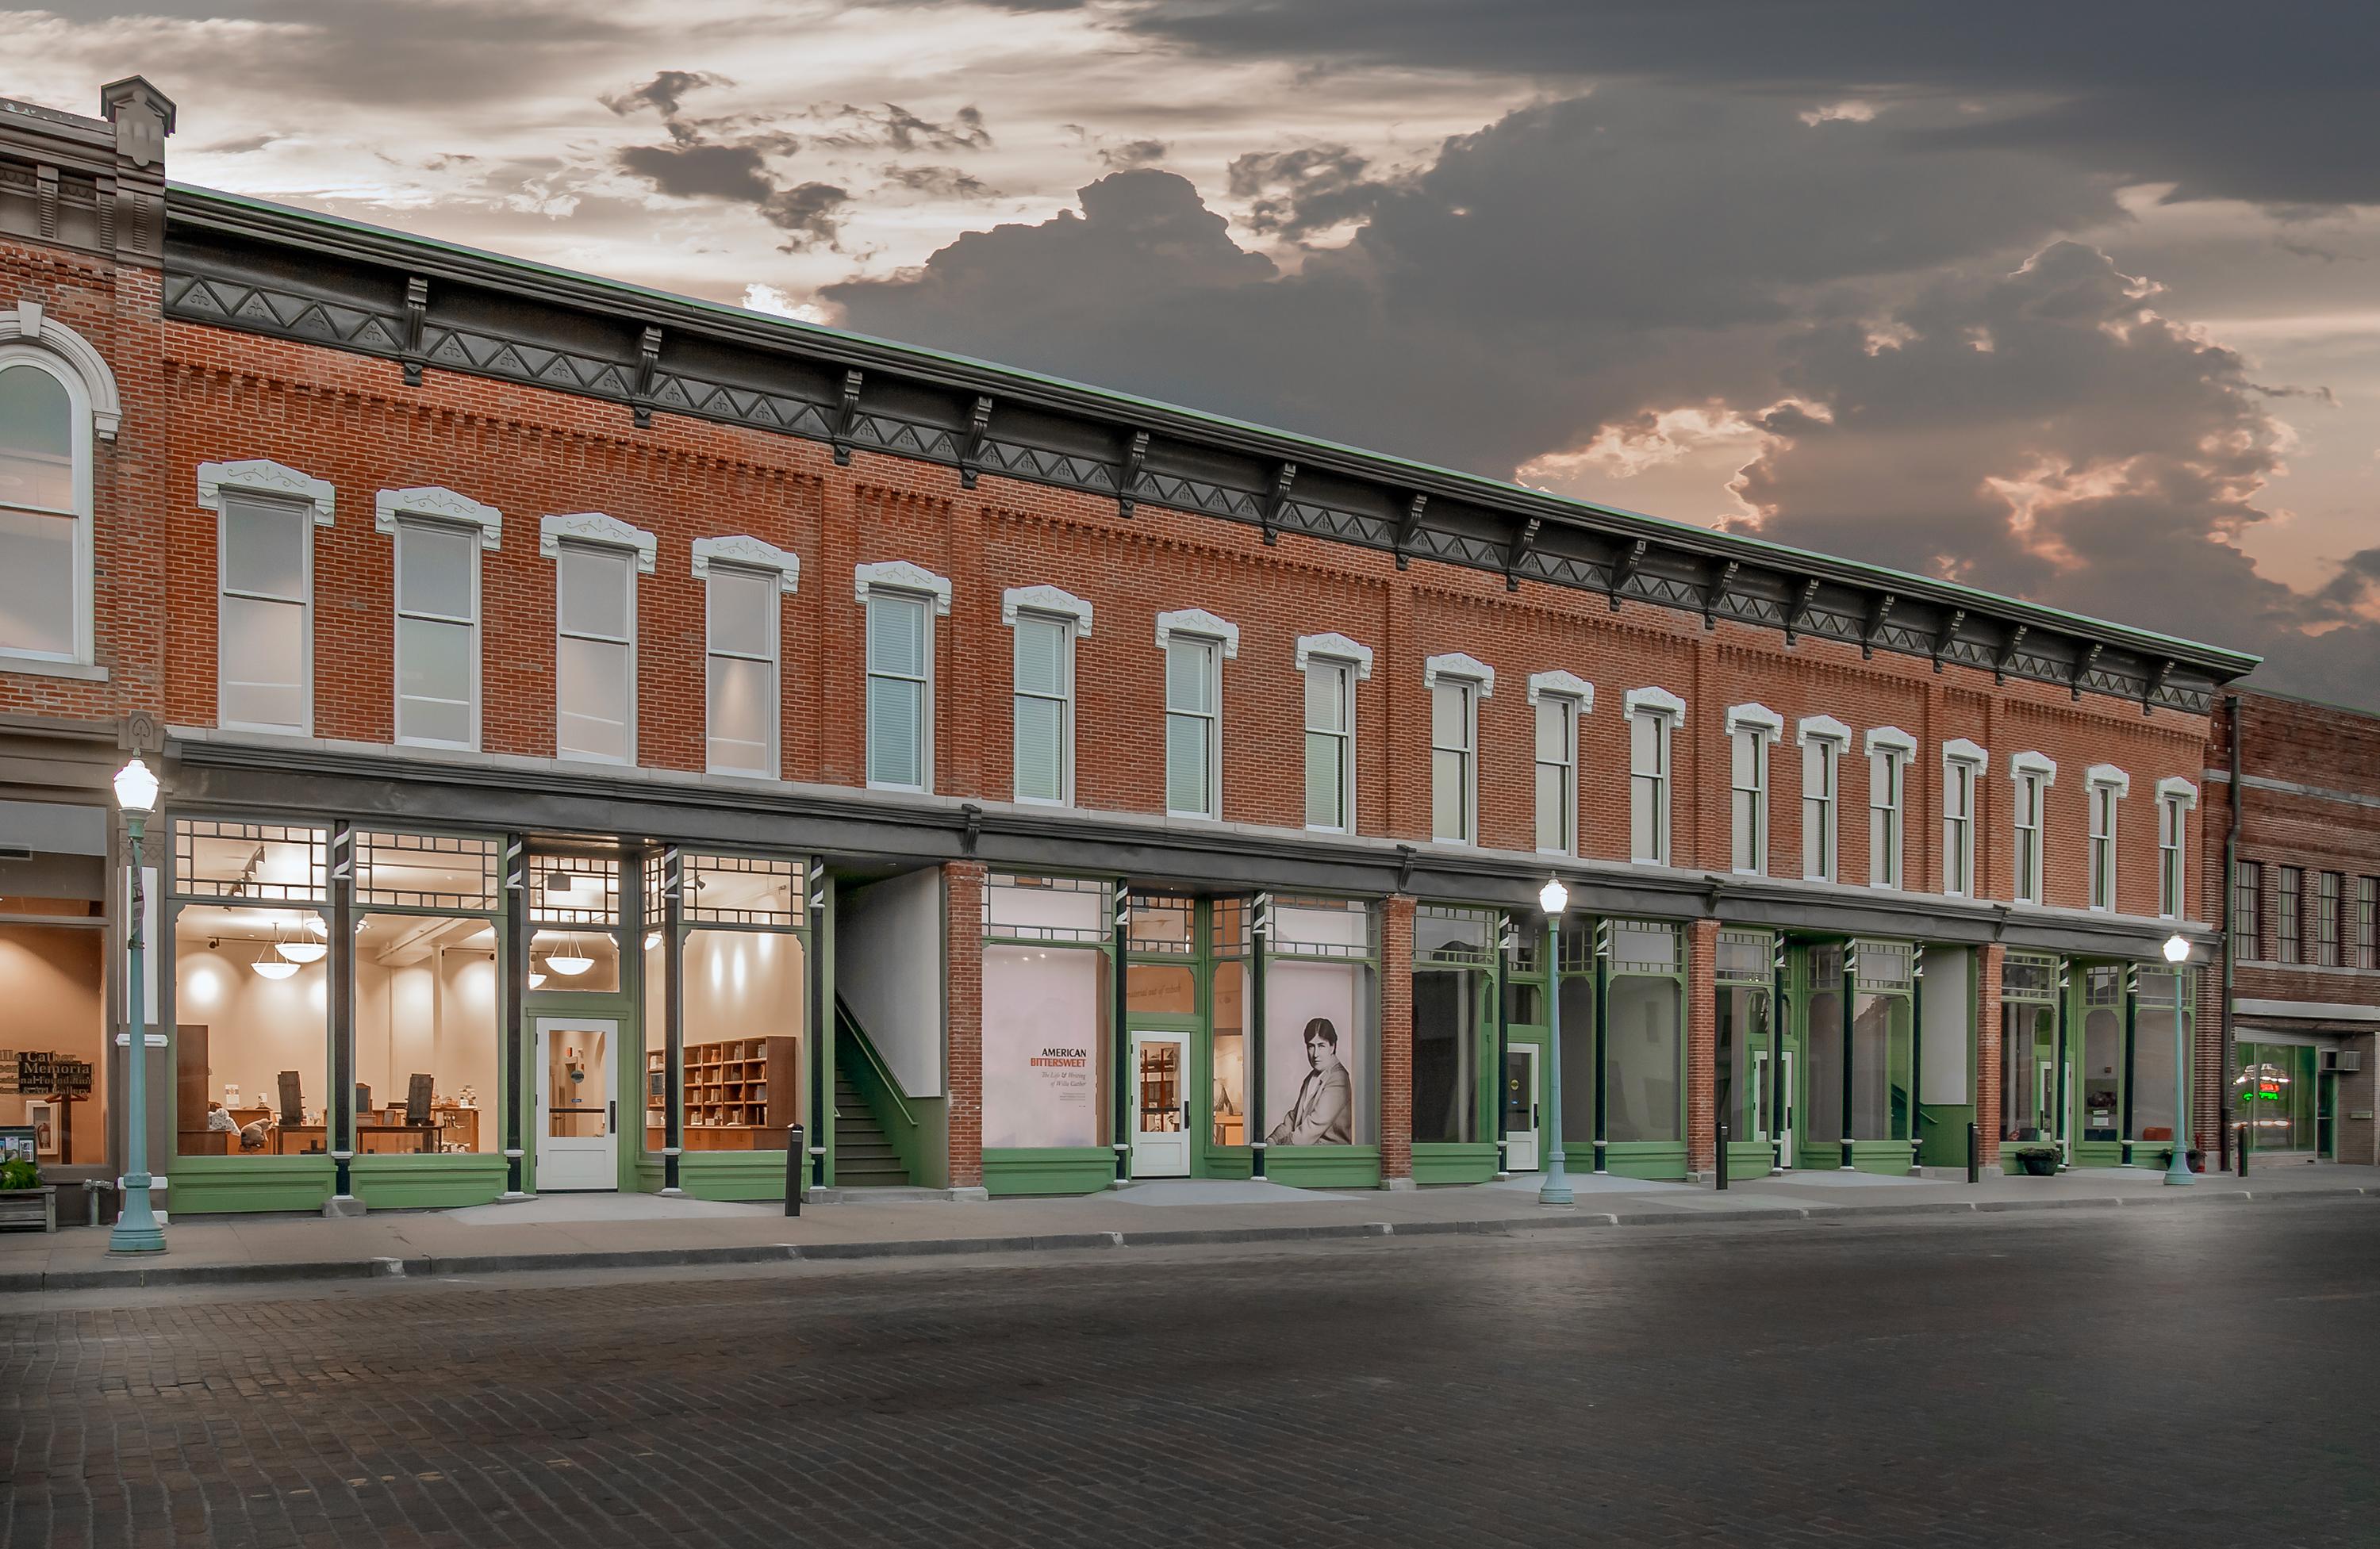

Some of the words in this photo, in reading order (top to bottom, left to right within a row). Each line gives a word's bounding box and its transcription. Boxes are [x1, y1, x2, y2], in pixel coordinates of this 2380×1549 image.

[0, 1049, 21, 1061] lla
[27, 1050, 76, 1062] Cather
[1042, 1048, 1087, 1057] AMERICAN
[24, 1062, 94, 1074] Memorial
[1031, 1058, 1085, 1068] BITTERSWEET
